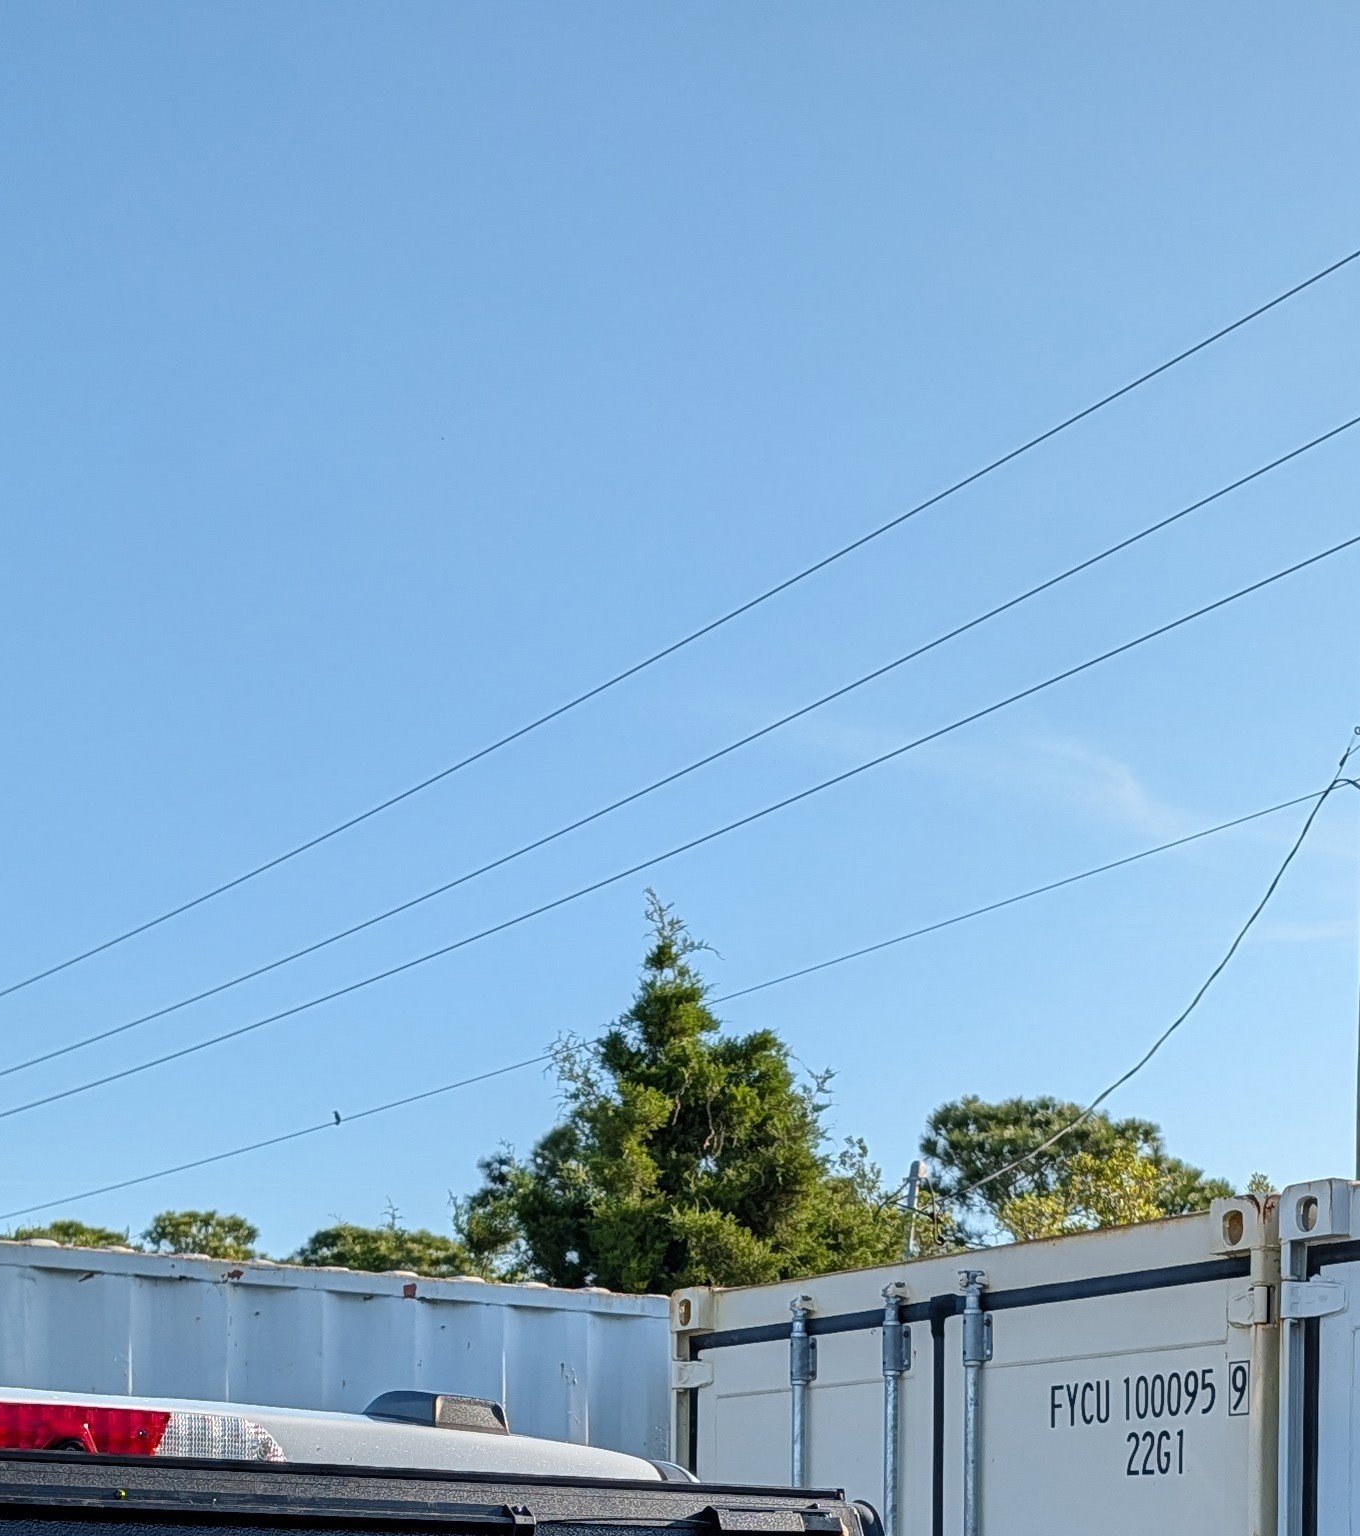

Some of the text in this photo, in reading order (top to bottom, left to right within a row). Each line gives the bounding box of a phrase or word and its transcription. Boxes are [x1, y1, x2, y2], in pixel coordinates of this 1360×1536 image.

[1051, 1365, 1247, 1428] FYCU 100095 9
[1127, 1429, 1184, 1476] 22G1
